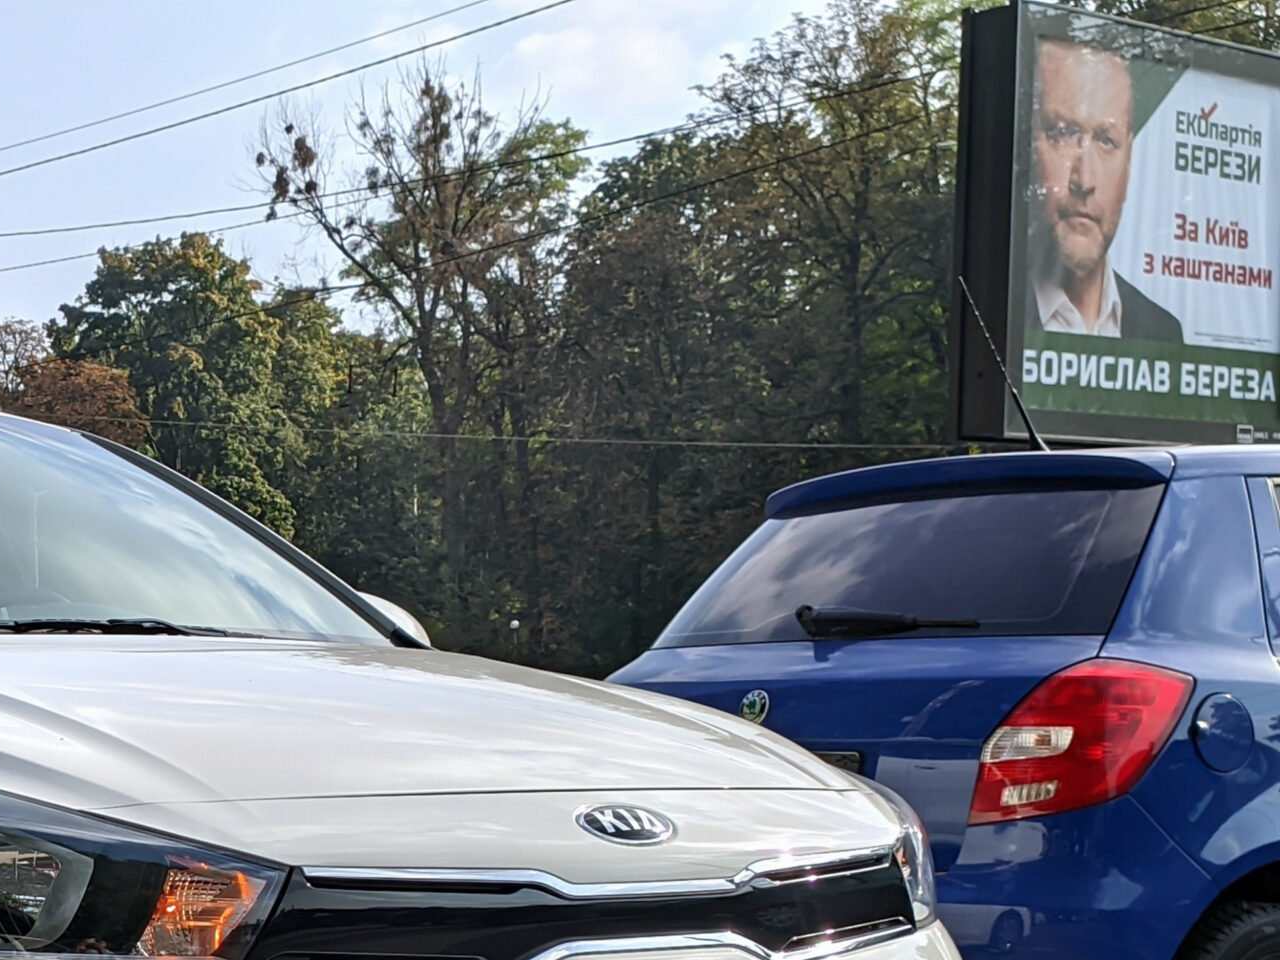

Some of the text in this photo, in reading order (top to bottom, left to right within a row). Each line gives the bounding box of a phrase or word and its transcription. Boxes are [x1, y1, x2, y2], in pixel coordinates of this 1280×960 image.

[1174, 141, 1261, 185] БЕРЕЗИ
[1173, 213, 1249, 249] За Київ
[1161, 254, 1272, 290] каштанами
[1022, 349, 1276, 402] БОРИСЛАВ БЕРЕЗА
[591, 808, 667, 834] KIA
